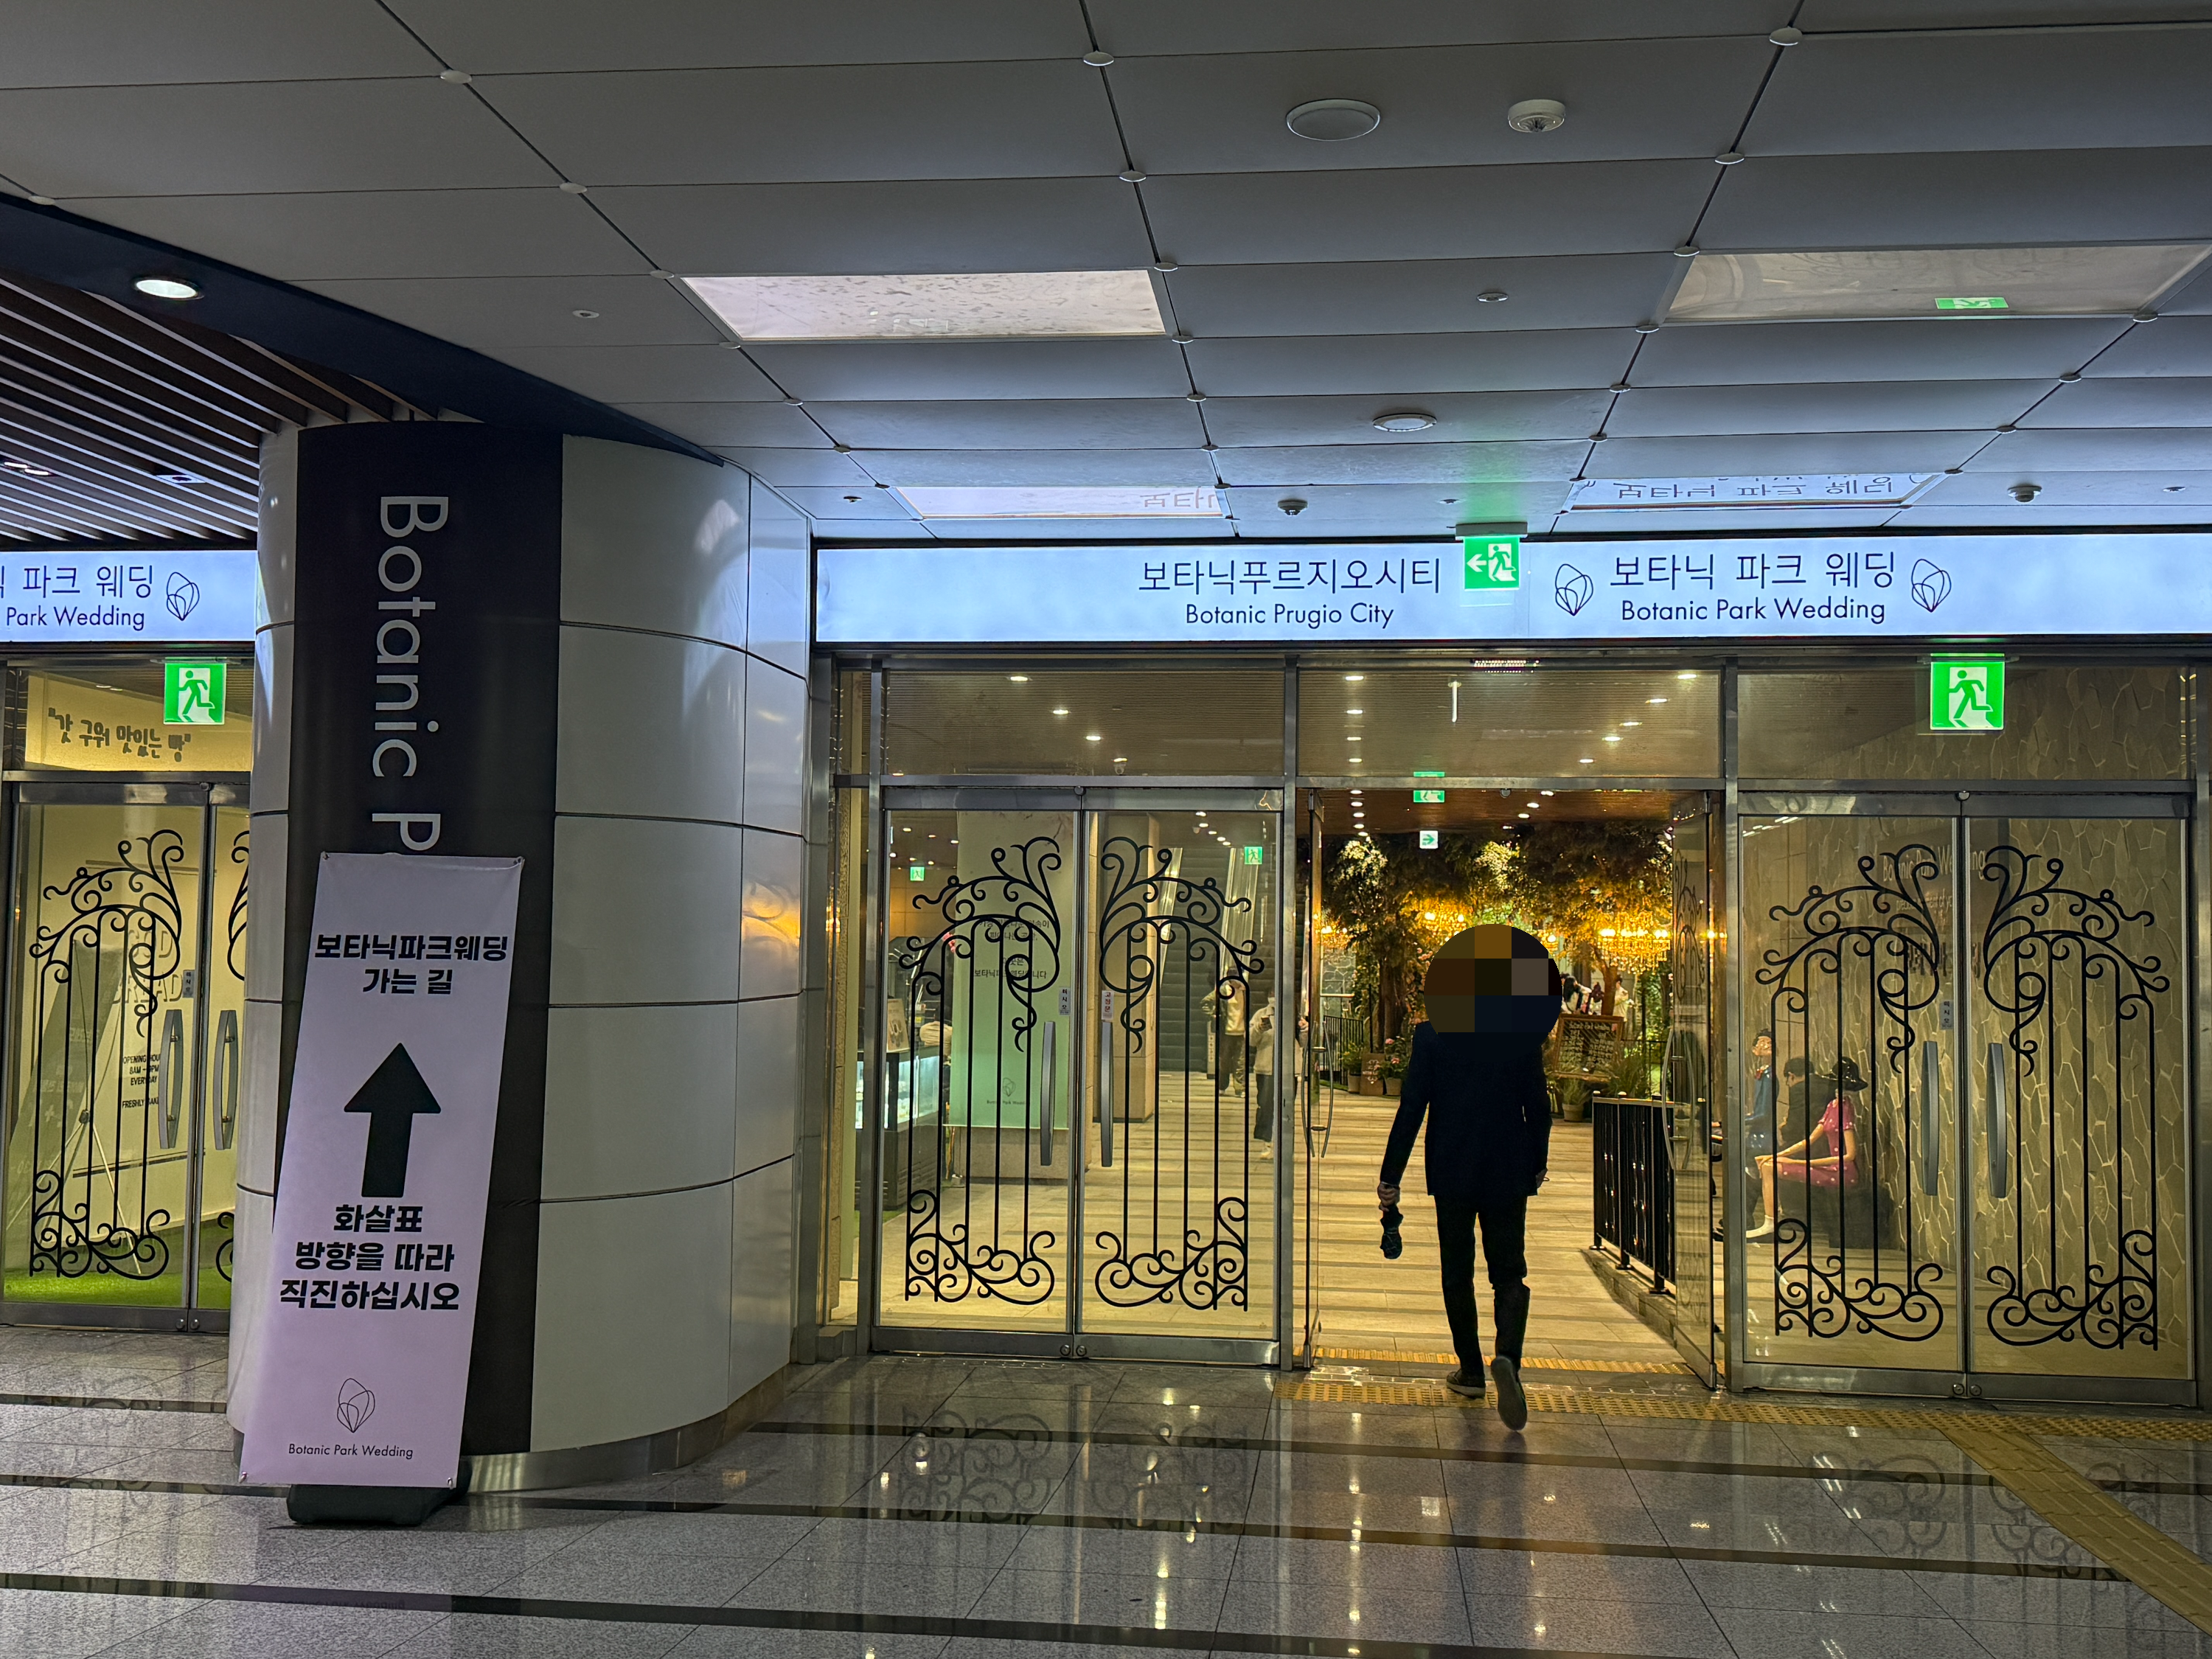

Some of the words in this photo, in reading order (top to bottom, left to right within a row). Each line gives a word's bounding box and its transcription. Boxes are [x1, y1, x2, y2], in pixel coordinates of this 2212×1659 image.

[22, 565, 80, 599] 파크
[96, 565, 153, 599] 웨딩
[1138, 557, 1439, 595] 보타닉푸르지오시티
[1610, 554, 1714, 591] 보타닉
[1736, 553, 1806, 589] 파크
[1826, 551, 1895, 588] 웨딩
[7, 605, 48, 626] Park
[53, 605, 145, 632] Wedding
[1186, 603, 1266, 624] Botanic
[1274, 603, 1342, 630] Prugio
[1350, 602, 1394, 630] City
[1622, 599, 1708, 621] Botanic
[1717, 597, 1767, 619] Park
[1773, 595, 1885, 625] Wedding
[372, 495, 449, 777] Botanic
[79, 720, 110, 748] 구워
[116, 725, 162, 759] 맛있는
[372, 813, 441, 851] P
[315, 933, 508, 961] 보타닉파크웨딩
[361, 968, 418, 995] 가는
[427, 969, 453, 995] 길
[150, 1054, 161, 1062] HOU
[333, 1204, 423, 1233] 화살표
[295, 1241, 385, 1271] 방향을
[394, 1243, 455, 1273] 따라
[279, 1279, 459, 1311] 직진하십시오
[288, 1443, 330, 1457] Botanic
[334, 1444, 358, 1458] Park
[361, 1444, 414, 1461] Wedding
